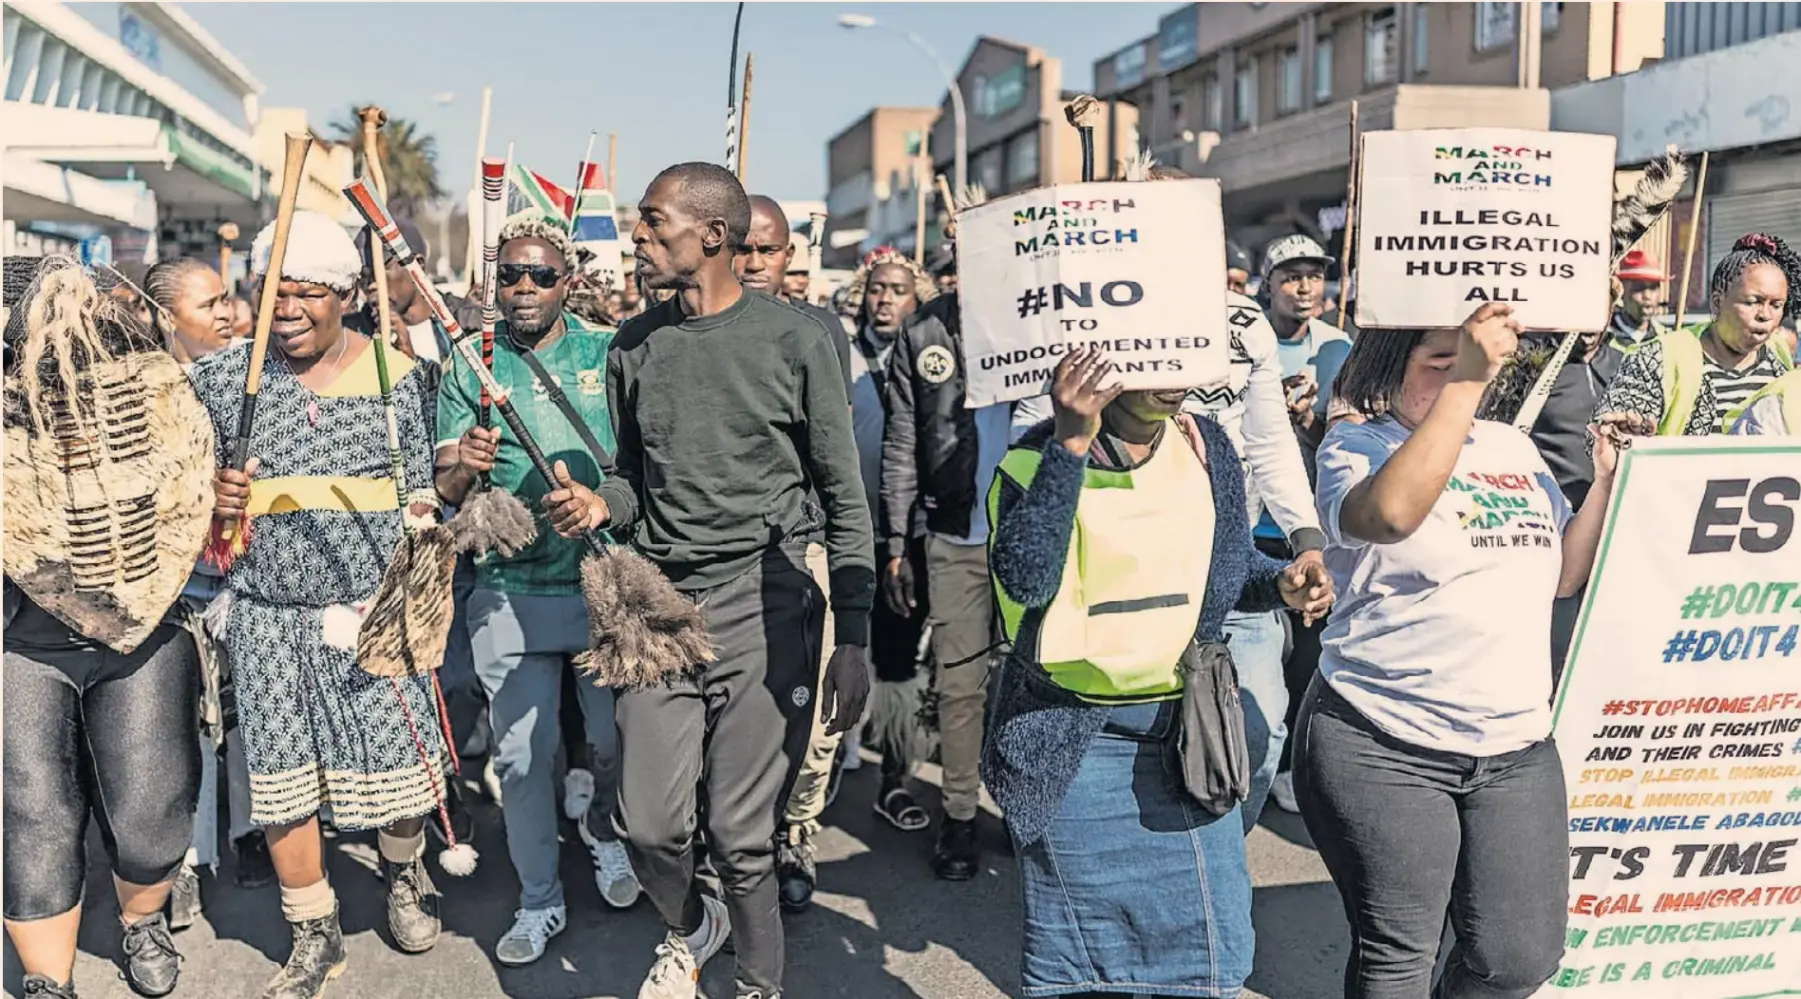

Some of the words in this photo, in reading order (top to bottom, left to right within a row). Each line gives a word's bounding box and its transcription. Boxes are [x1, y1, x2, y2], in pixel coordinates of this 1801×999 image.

[1435, 145, 1552, 161] MARCH
[1474, 160, 1523, 170] AND
[1433, 171, 1552, 187] MARCH
[1047, 217, 1098, 232] AND
[1420, 210, 1561, 227] ILLEGAL
[1014, 228, 1139, 257] MARCH
[1374, 235, 1601, 255] IMMIGRATION
[1406, 261, 1528, 277] HURTS
[1539, 262, 1575, 279] US
[1017, 280, 1144, 319] #NO
[1464, 286, 1529, 302] ALL
[1060, 318, 1099, 332] TO
[1004, 359, 1184, 388] IMMANTS
[1688, 476, 1801, 555] ES
[1470, 535, 1508, 549] UNTIL
[1511, 534, 1530, 548] WE
[1534, 534, 1553, 549] WIN
[1662, 624, 1800, 664] #DOIT4
[1593, 724, 1644, 740] JOIN
[1650, 724, 1678, 740] US
[1682, 722, 1706, 738] IN
[1709, 717, 1801, 737] FIGHTING
[1585, 747, 1632, 763] AND
[1641, 746, 1702, 764] THEIR
[1708, 742, 1784, 759] CRIMES
[1578, 768, 1634, 784] STOP
[1640, 767, 1720, 785] ILLEGAL
[1569, 793, 1637, 810] LEGAL
[1642, 789, 1773, 808] IMMIGRATION
[1568, 815, 1710, 835] SEKWANELE
[1568, 845, 1650, 880] T'S
[1672, 837, 1799, 878] TIME
[1568, 893, 1643, 918] EGAL
[1592, 917, 1787, 950] ENFORCEMENT
[1549, 964, 1596, 988] BE
[1599, 961, 1626, 984] IS
[1632, 961, 1653, 982] A
[1661, 951, 1777, 980] CRIMINAL
